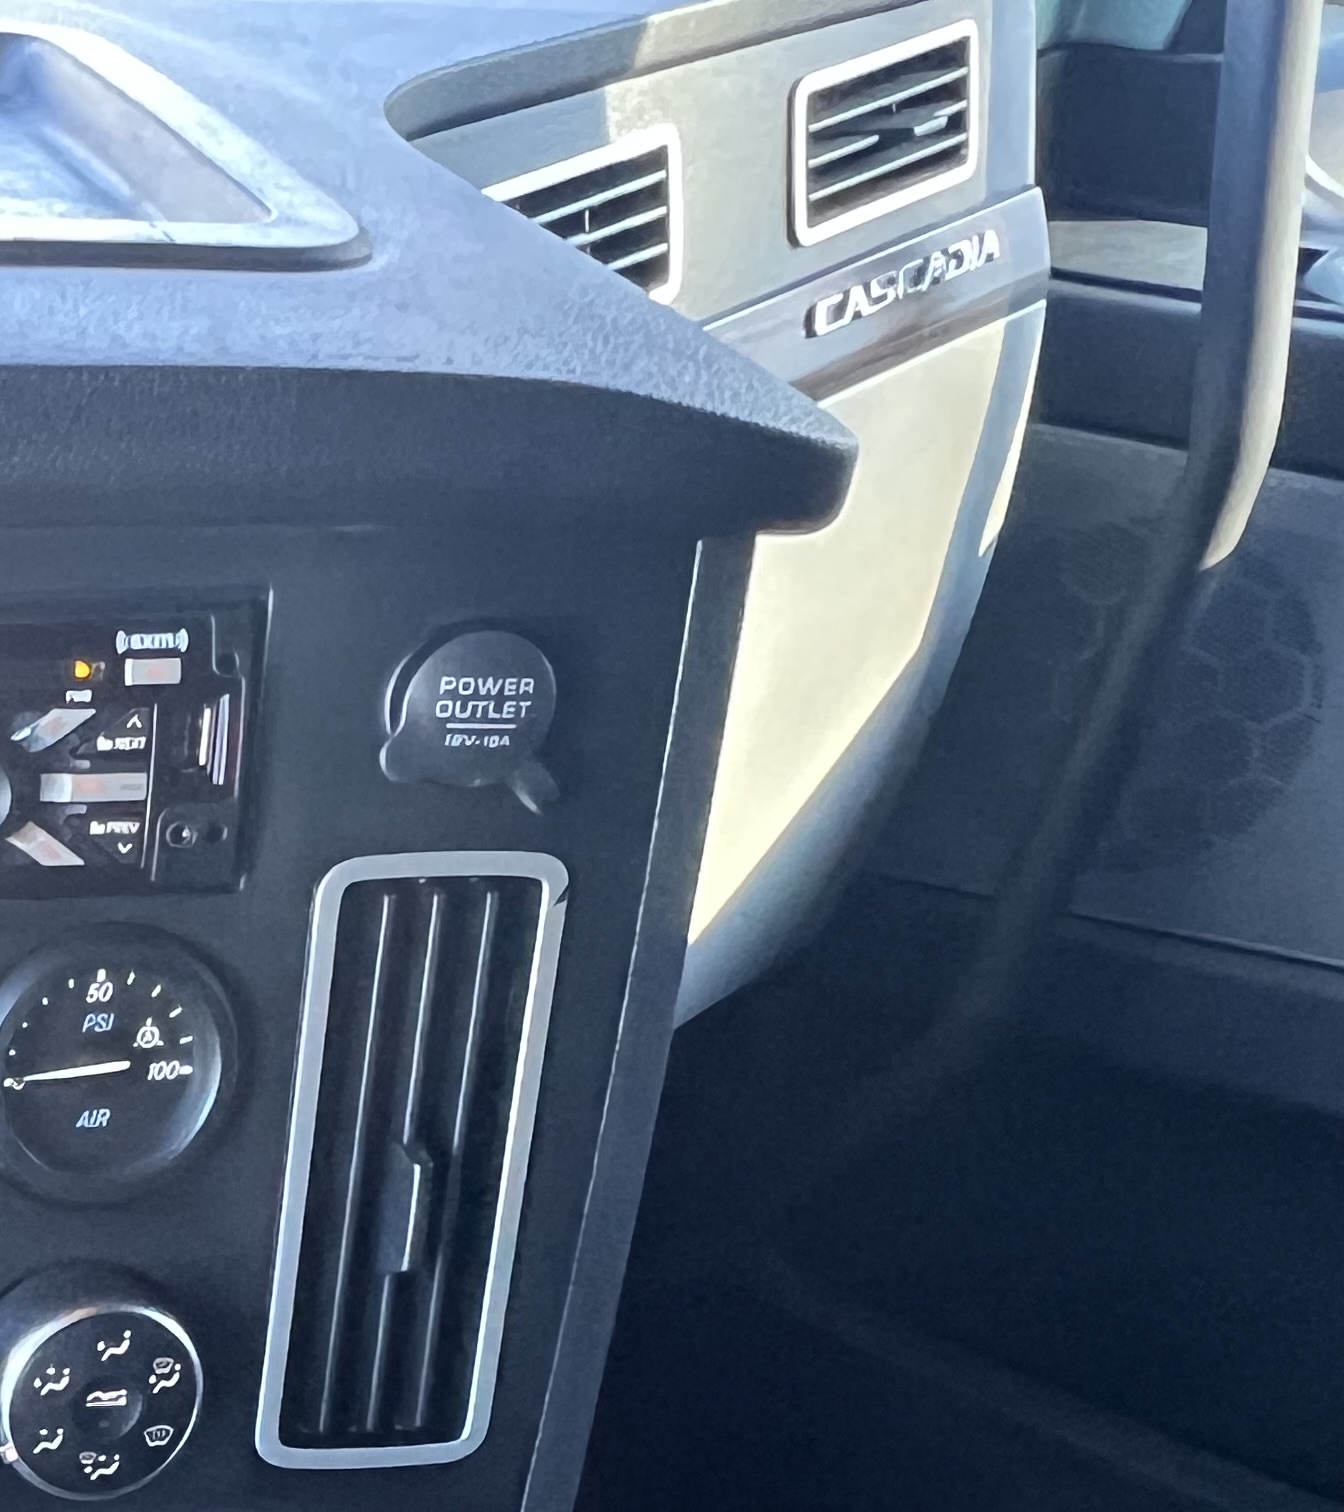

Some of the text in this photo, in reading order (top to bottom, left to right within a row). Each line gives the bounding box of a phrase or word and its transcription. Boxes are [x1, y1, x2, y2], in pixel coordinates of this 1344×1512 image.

[813, 229, 1001, 336] CASCADIA
[439, 676, 534, 696] POWER
[435, 700, 532, 718] OUTLET
[85, 981, 114, 1004] 50
[81, 1013, 115, 1033] PSI
[146, 1060, 181, 1081] 100
[75, 1108, 111, 1128] AIR
